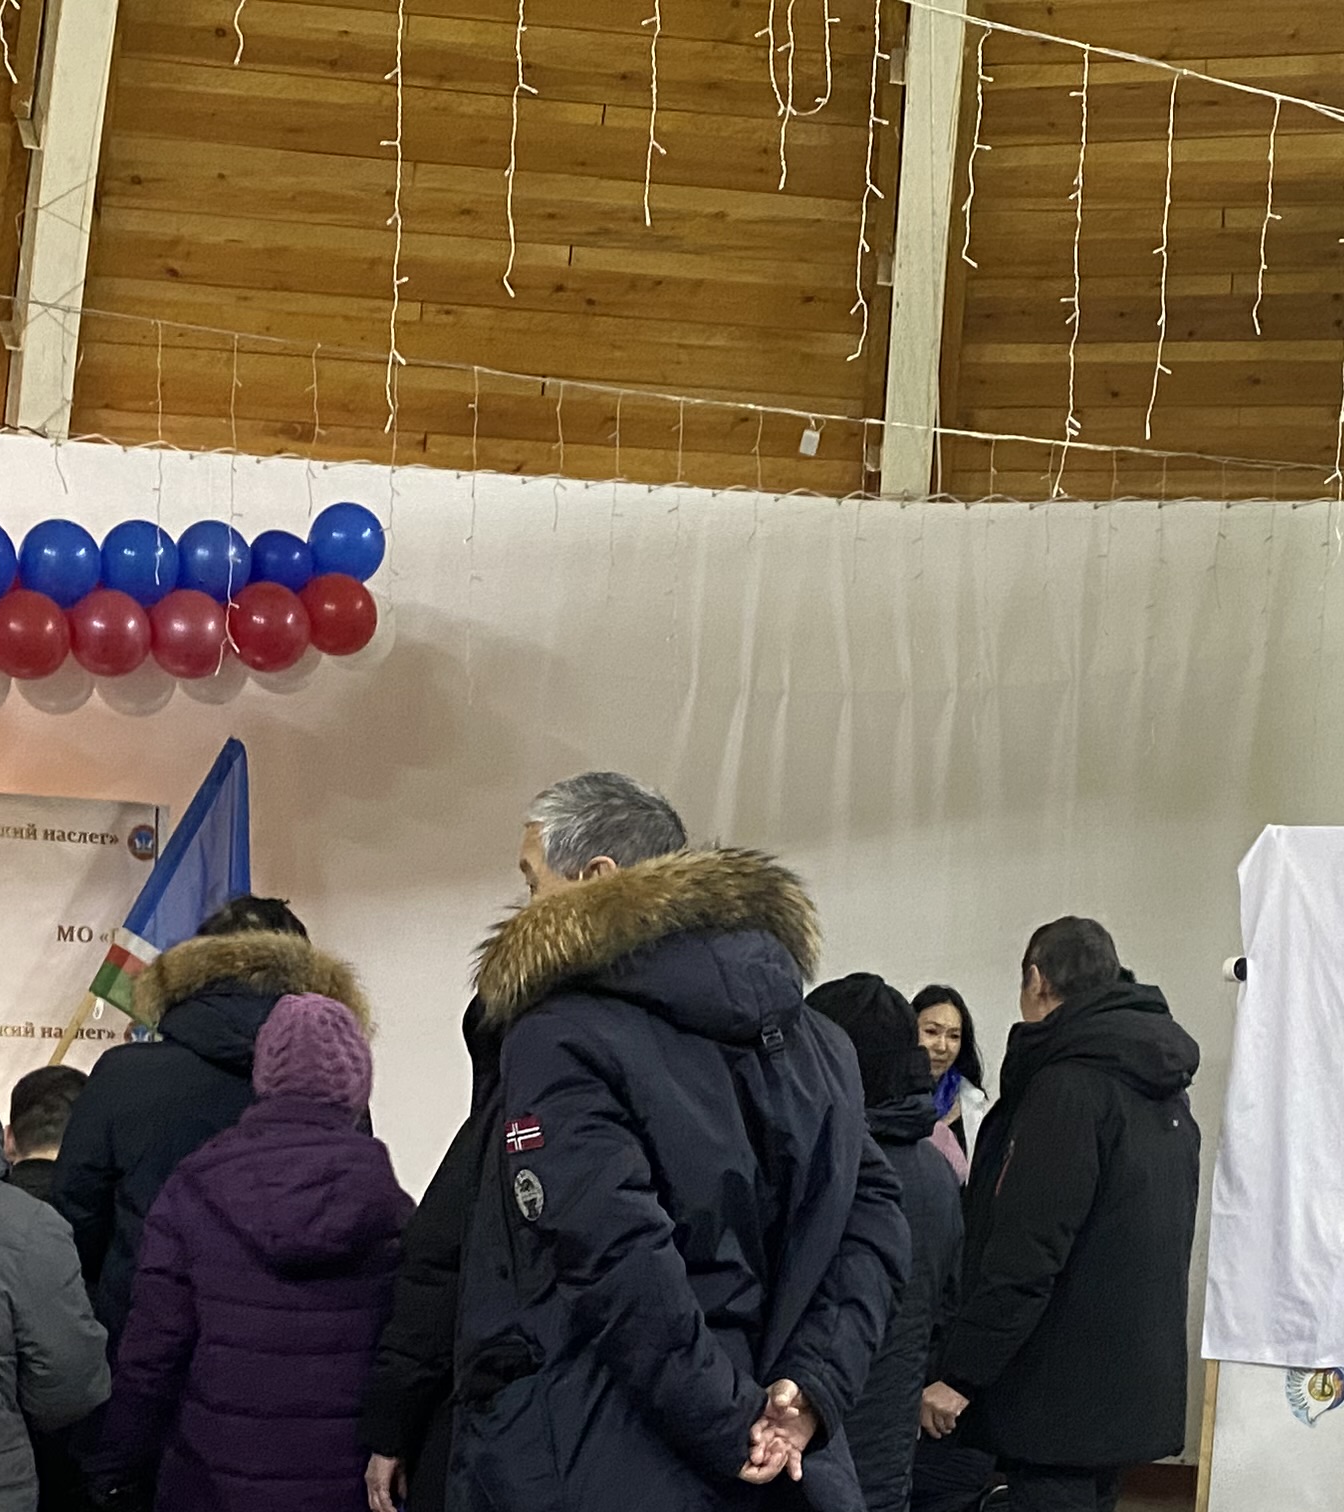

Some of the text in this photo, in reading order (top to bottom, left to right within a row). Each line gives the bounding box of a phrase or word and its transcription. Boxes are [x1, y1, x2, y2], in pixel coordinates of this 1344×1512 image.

[43, 829, 119, 845] наслег»
[57, 925, 94, 943] МО
[41, 1026, 116, 1040] налег»
